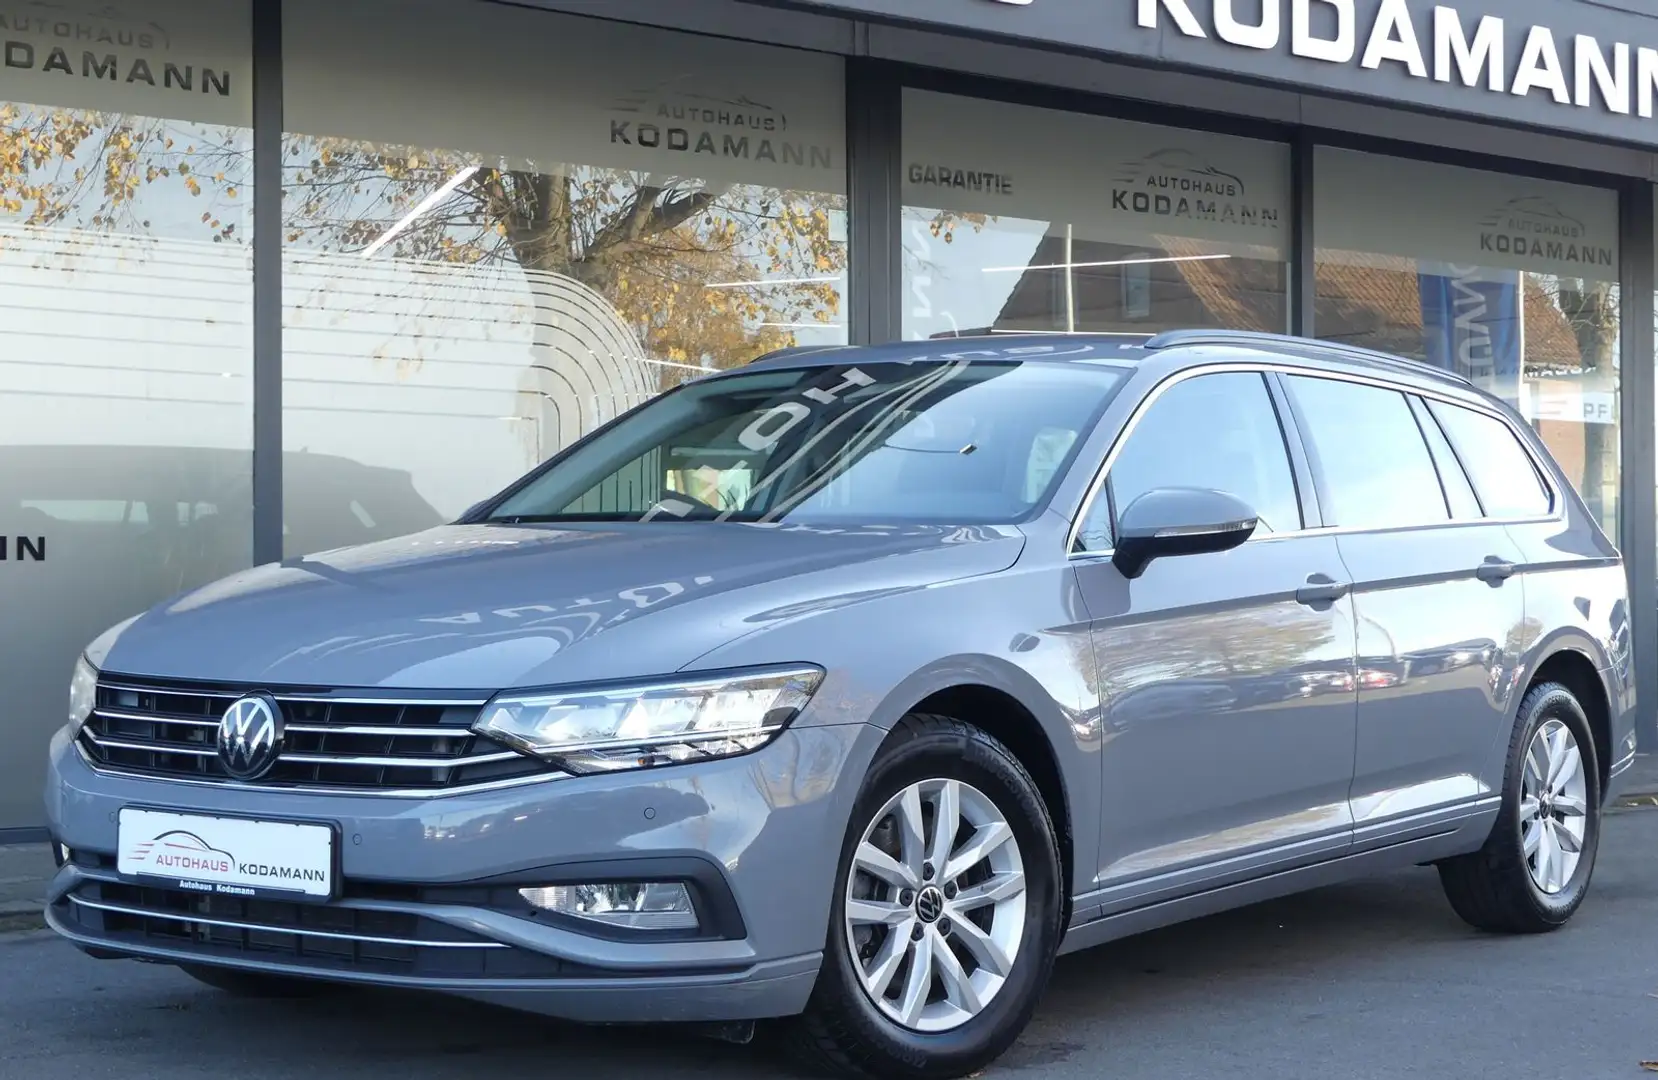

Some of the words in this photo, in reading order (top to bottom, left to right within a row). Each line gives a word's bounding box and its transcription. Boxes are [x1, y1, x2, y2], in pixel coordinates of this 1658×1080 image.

[656, 103, 775, 131] AUTOHAUS
[610, 119, 831, 168] KODAMANN
[908, 163, 1013, 195] GARANTIE
[1147, 175, 1236, 197] AUTOHAUS
[1112, 189, 1279, 229] KODAMANN
[1507, 218, 1580, 239] AUTOHAUS
[1480, 232, 1613, 266] KODAMANN
[156, 854, 229, 873] AUTOHAUS
[239, 863, 325, 882] KODAMANN
[179, 880, 212, 892] Autohaus
[216, 884, 255, 896] Kodamann
